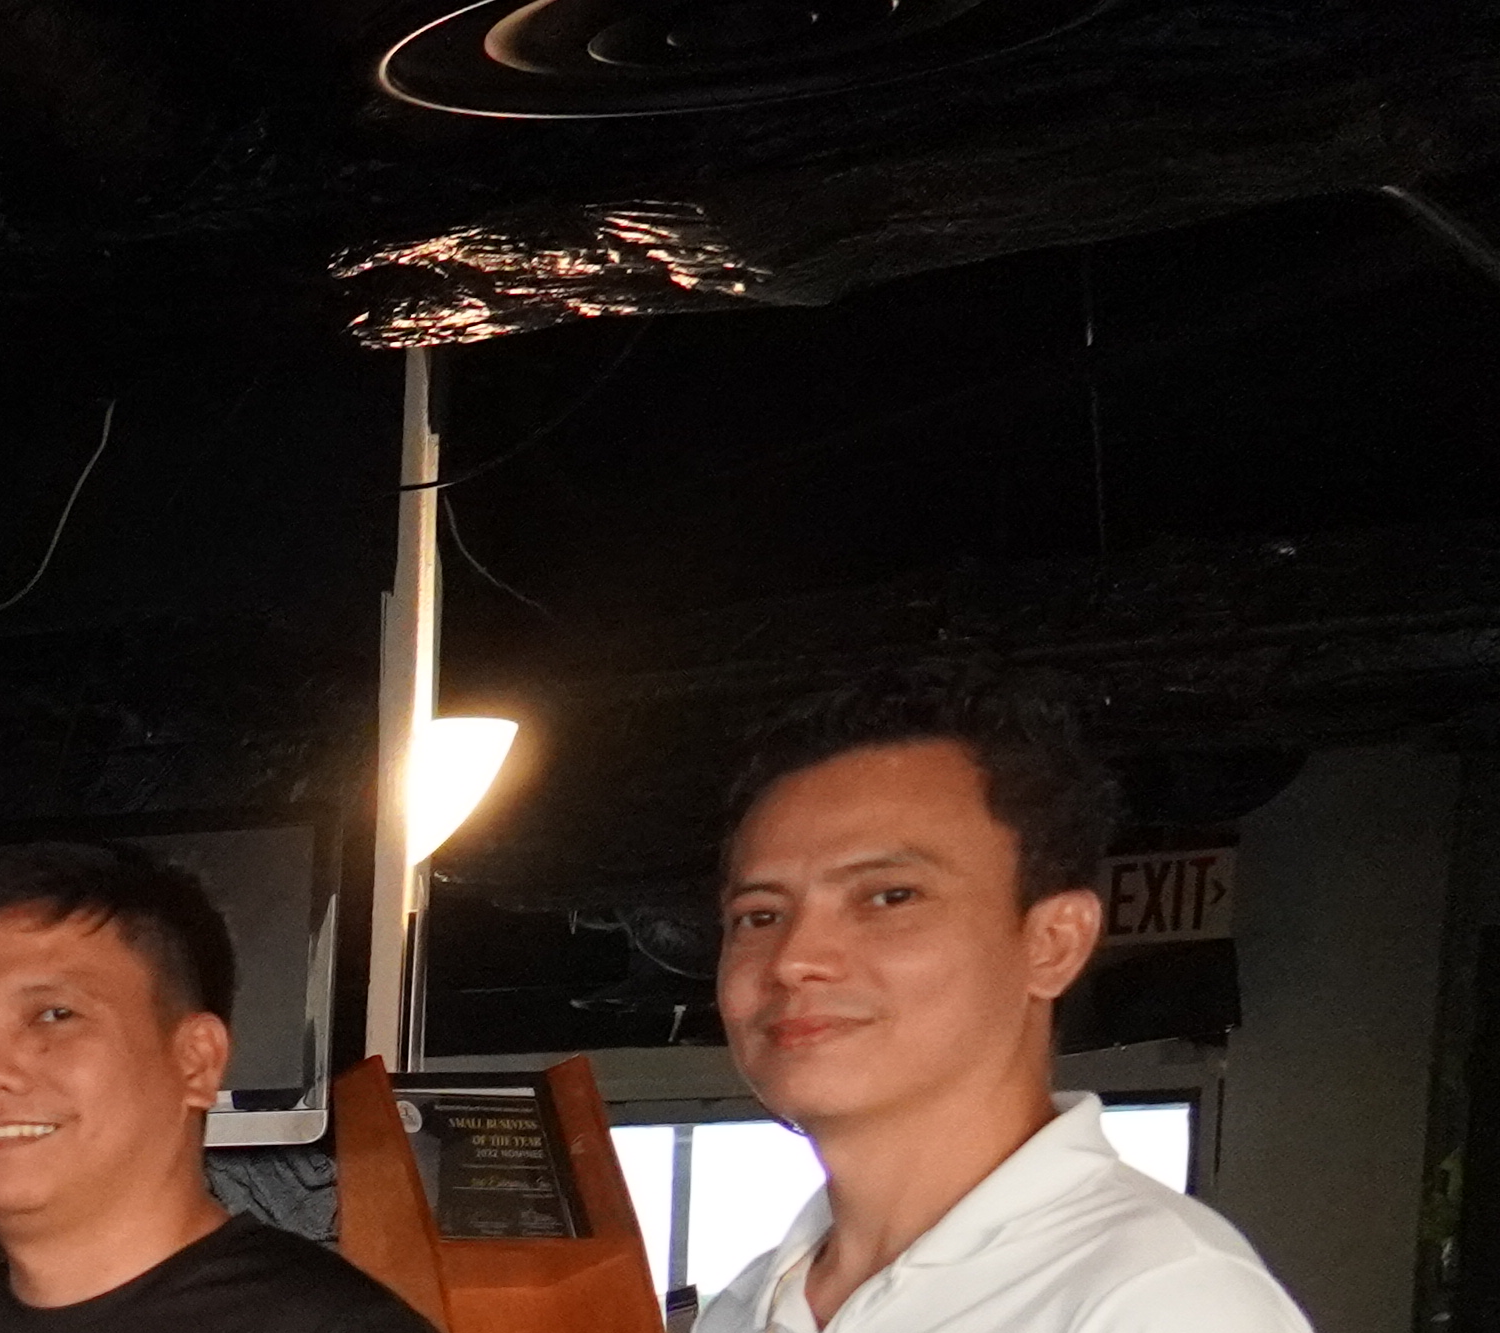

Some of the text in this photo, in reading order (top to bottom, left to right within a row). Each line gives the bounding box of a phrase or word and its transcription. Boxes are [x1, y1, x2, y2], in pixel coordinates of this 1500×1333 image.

[1107, 857, 1217, 936] EXIT
[486, 1117, 538, 1131] BUSINESS
[472, 1134, 542, 1147] OF THE YEAR
